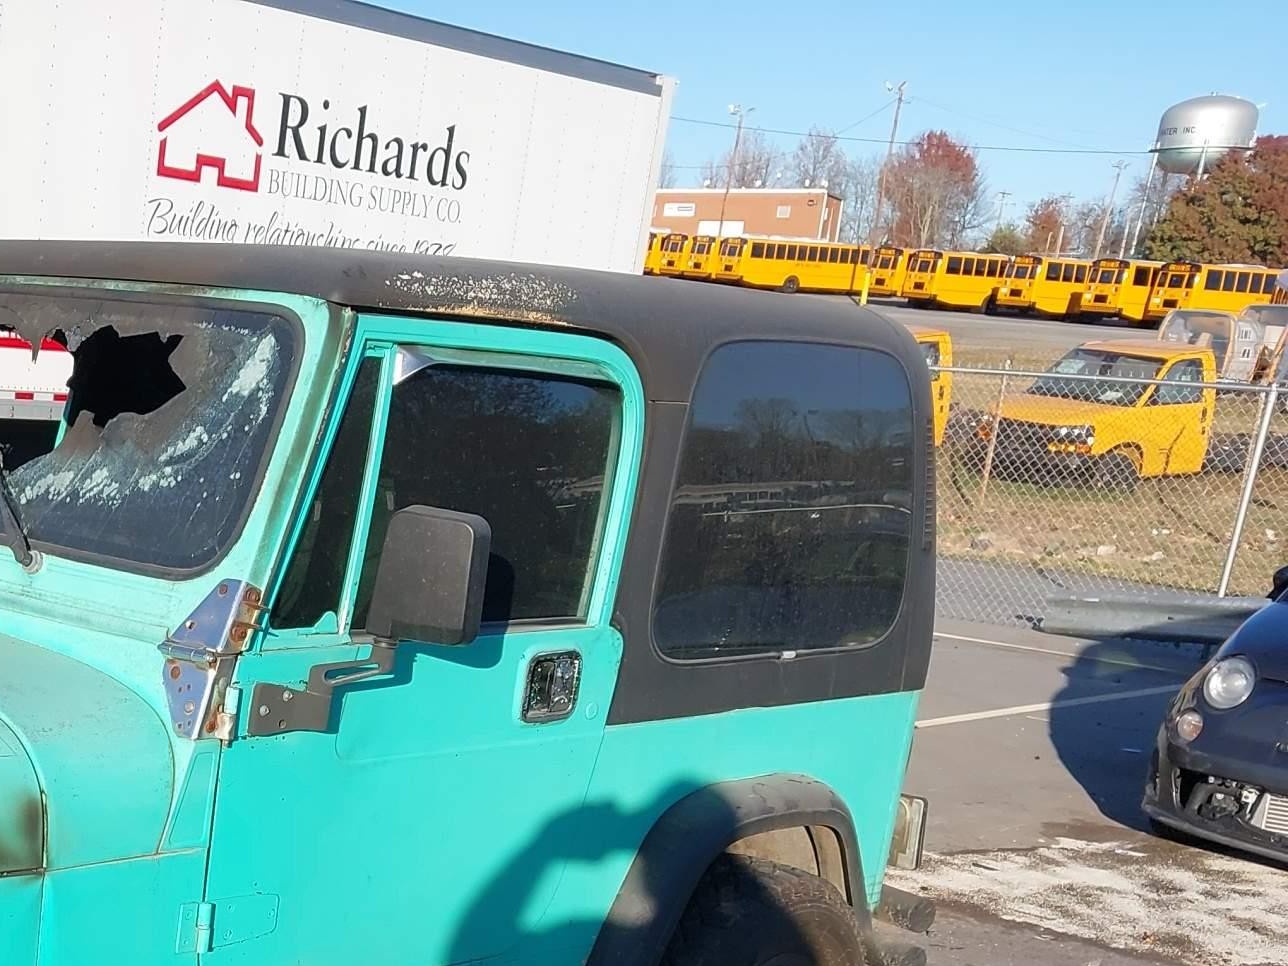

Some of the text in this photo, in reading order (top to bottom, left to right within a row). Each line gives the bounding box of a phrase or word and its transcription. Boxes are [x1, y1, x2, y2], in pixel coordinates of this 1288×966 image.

[272, 91, 470, 191] Richards
[267, 168, 462, 224] BUILDING SUPPLY CO.
